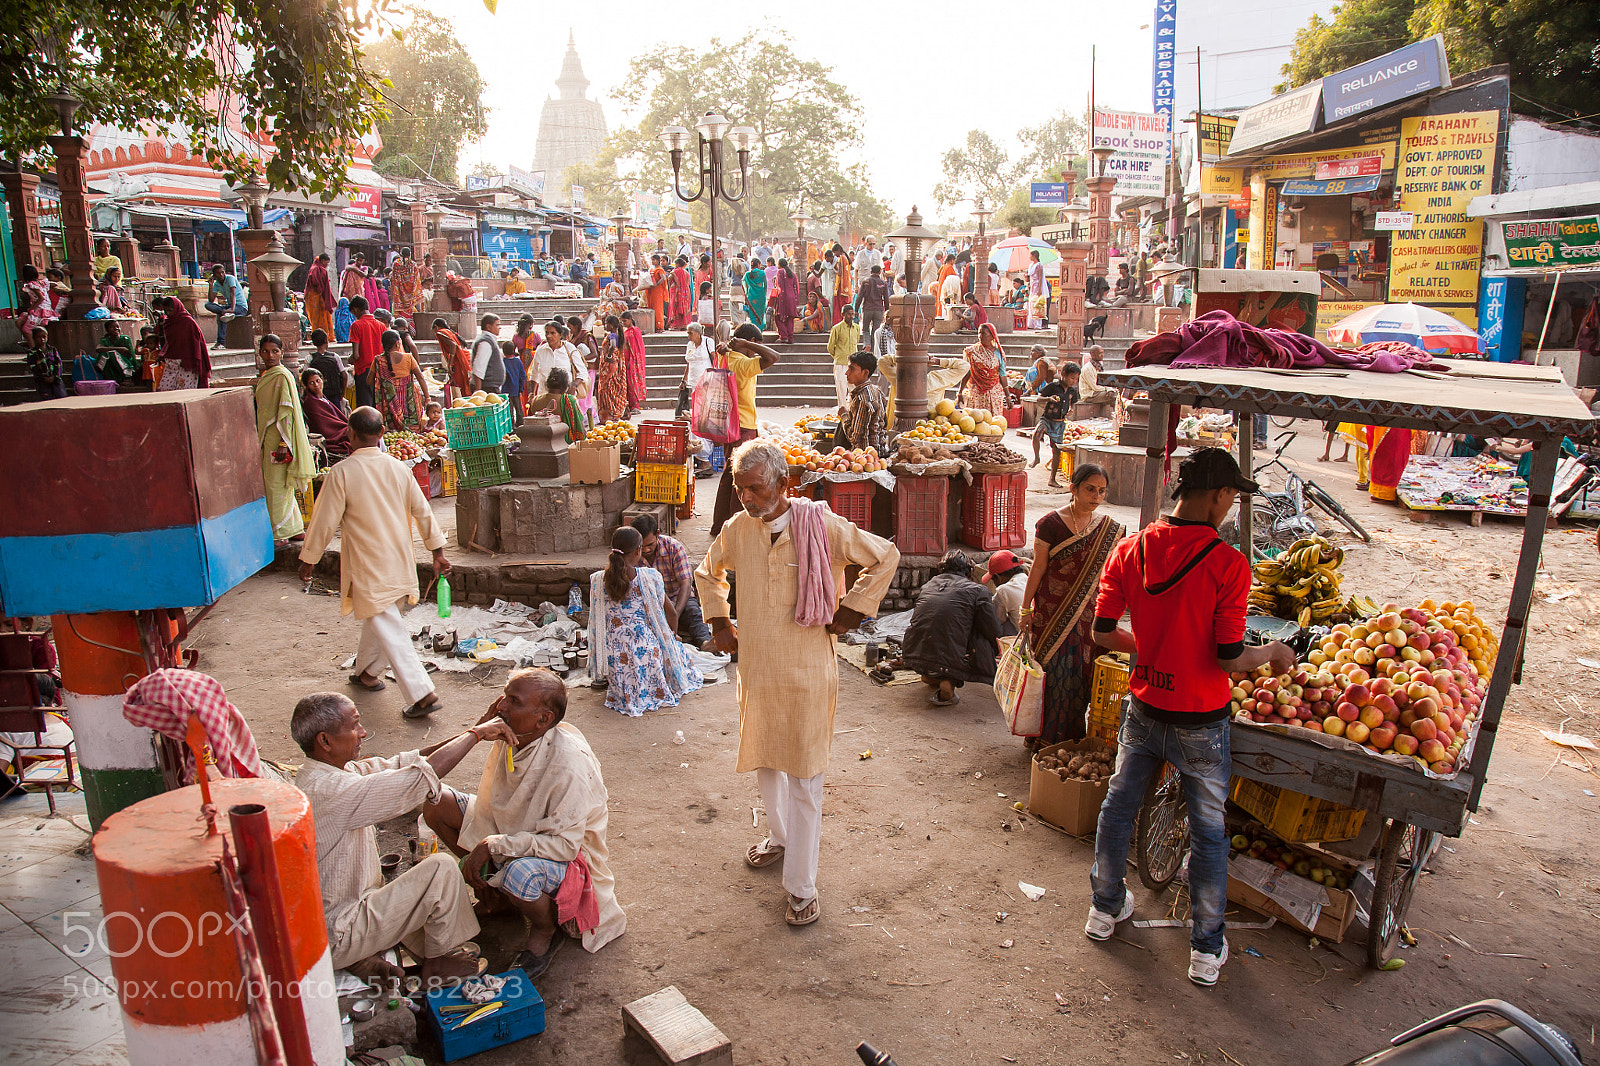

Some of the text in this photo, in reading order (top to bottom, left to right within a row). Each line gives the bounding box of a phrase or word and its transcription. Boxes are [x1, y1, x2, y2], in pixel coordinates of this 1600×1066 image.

[1158, 28, 1174, 37] &
[1262, 106, 1299, 123] UNION
[1094, 113, 1119, 129] MIDDLE
[1138, 117, 1165, 132] TRAVELS
[1420, 118, 1479, 131] ARAHANT
[1133, 139, 1164, 150] SHOP
[1406, 133, 1495, 147] TOURS & TRAVELS
[1406, 149, 1483, 162] GOVT. APPROVED
[1276, 157, 1311, 169] ARAHANT
[1405, 165, 1485, 177] DEPT. OF TOURISM
[1325, 181, 1346, 193] 88
[1404, 180, 1482, 193] RESERVE BANK OF
[1428, 196, 1452, 207] INDIA
[1424, 212, 1475, 224] AUTHORISED
[1397, 228, 1466, 240] MONEY CHANGER
[1506, 221, 1599, 239] SHAHI Tailors
[1509, 241, 1554, 263] शाही
[1435, 261, 1478, 270] ALL TRAVEL
[1410, 277, 1450, 287] RELATED
[1391, 289, 1474, 298] INFORMATION & SERVICES
